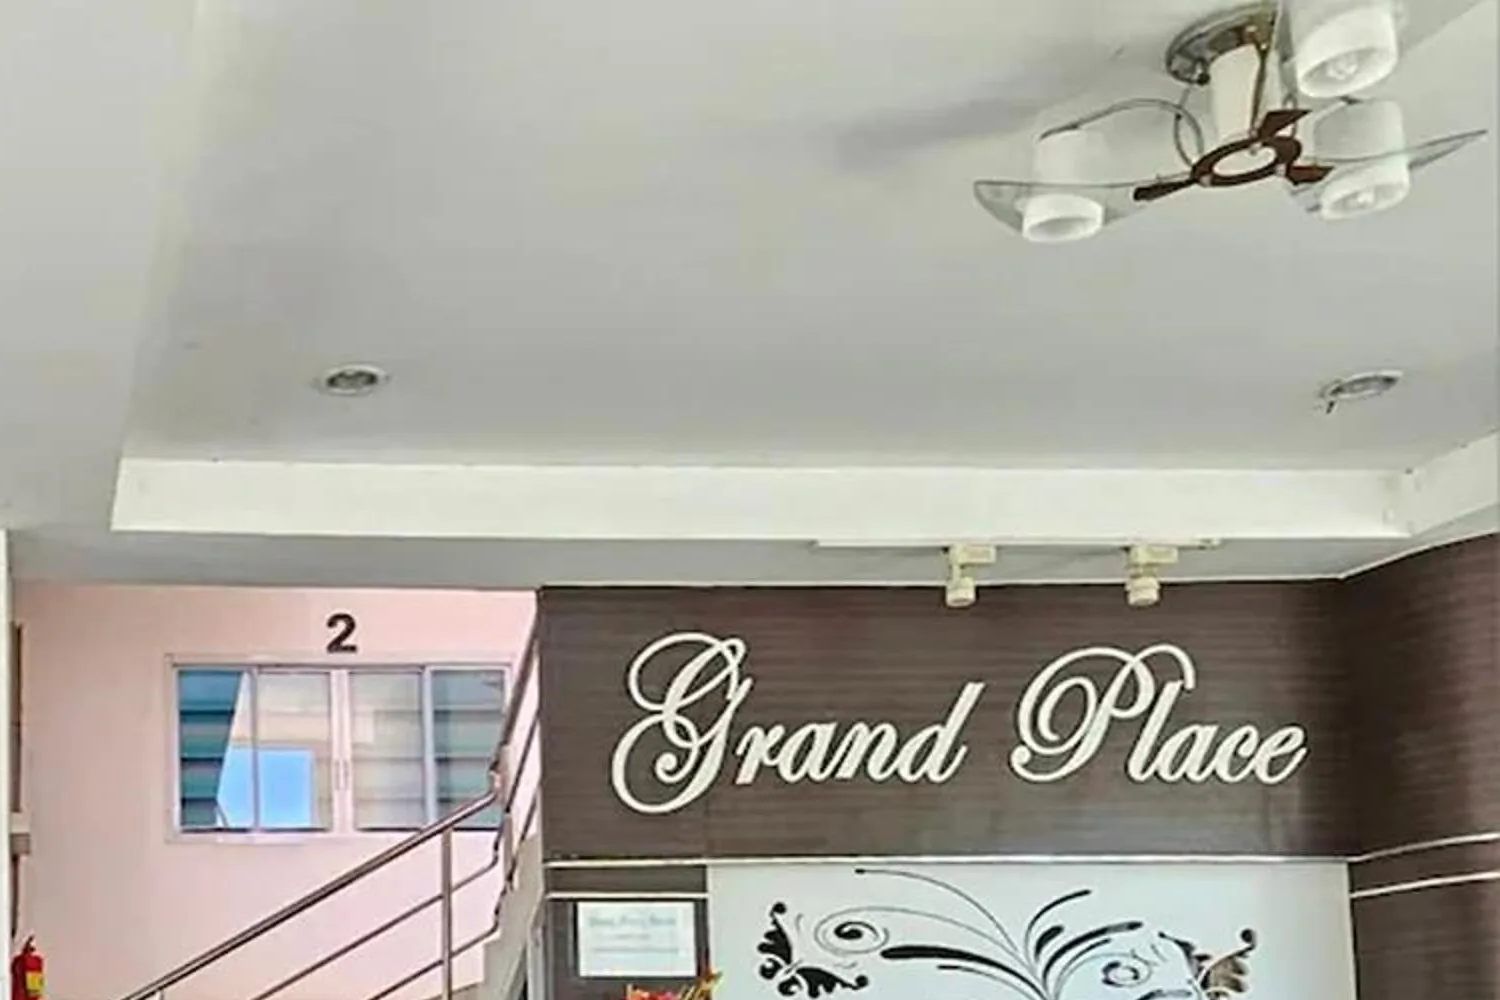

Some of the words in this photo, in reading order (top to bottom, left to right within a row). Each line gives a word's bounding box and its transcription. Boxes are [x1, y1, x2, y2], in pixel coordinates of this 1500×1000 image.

[326, 613, 357, 654] 2
[611, 632, 985, 813] Grand
[1010, 643, 1307, 784] Place
